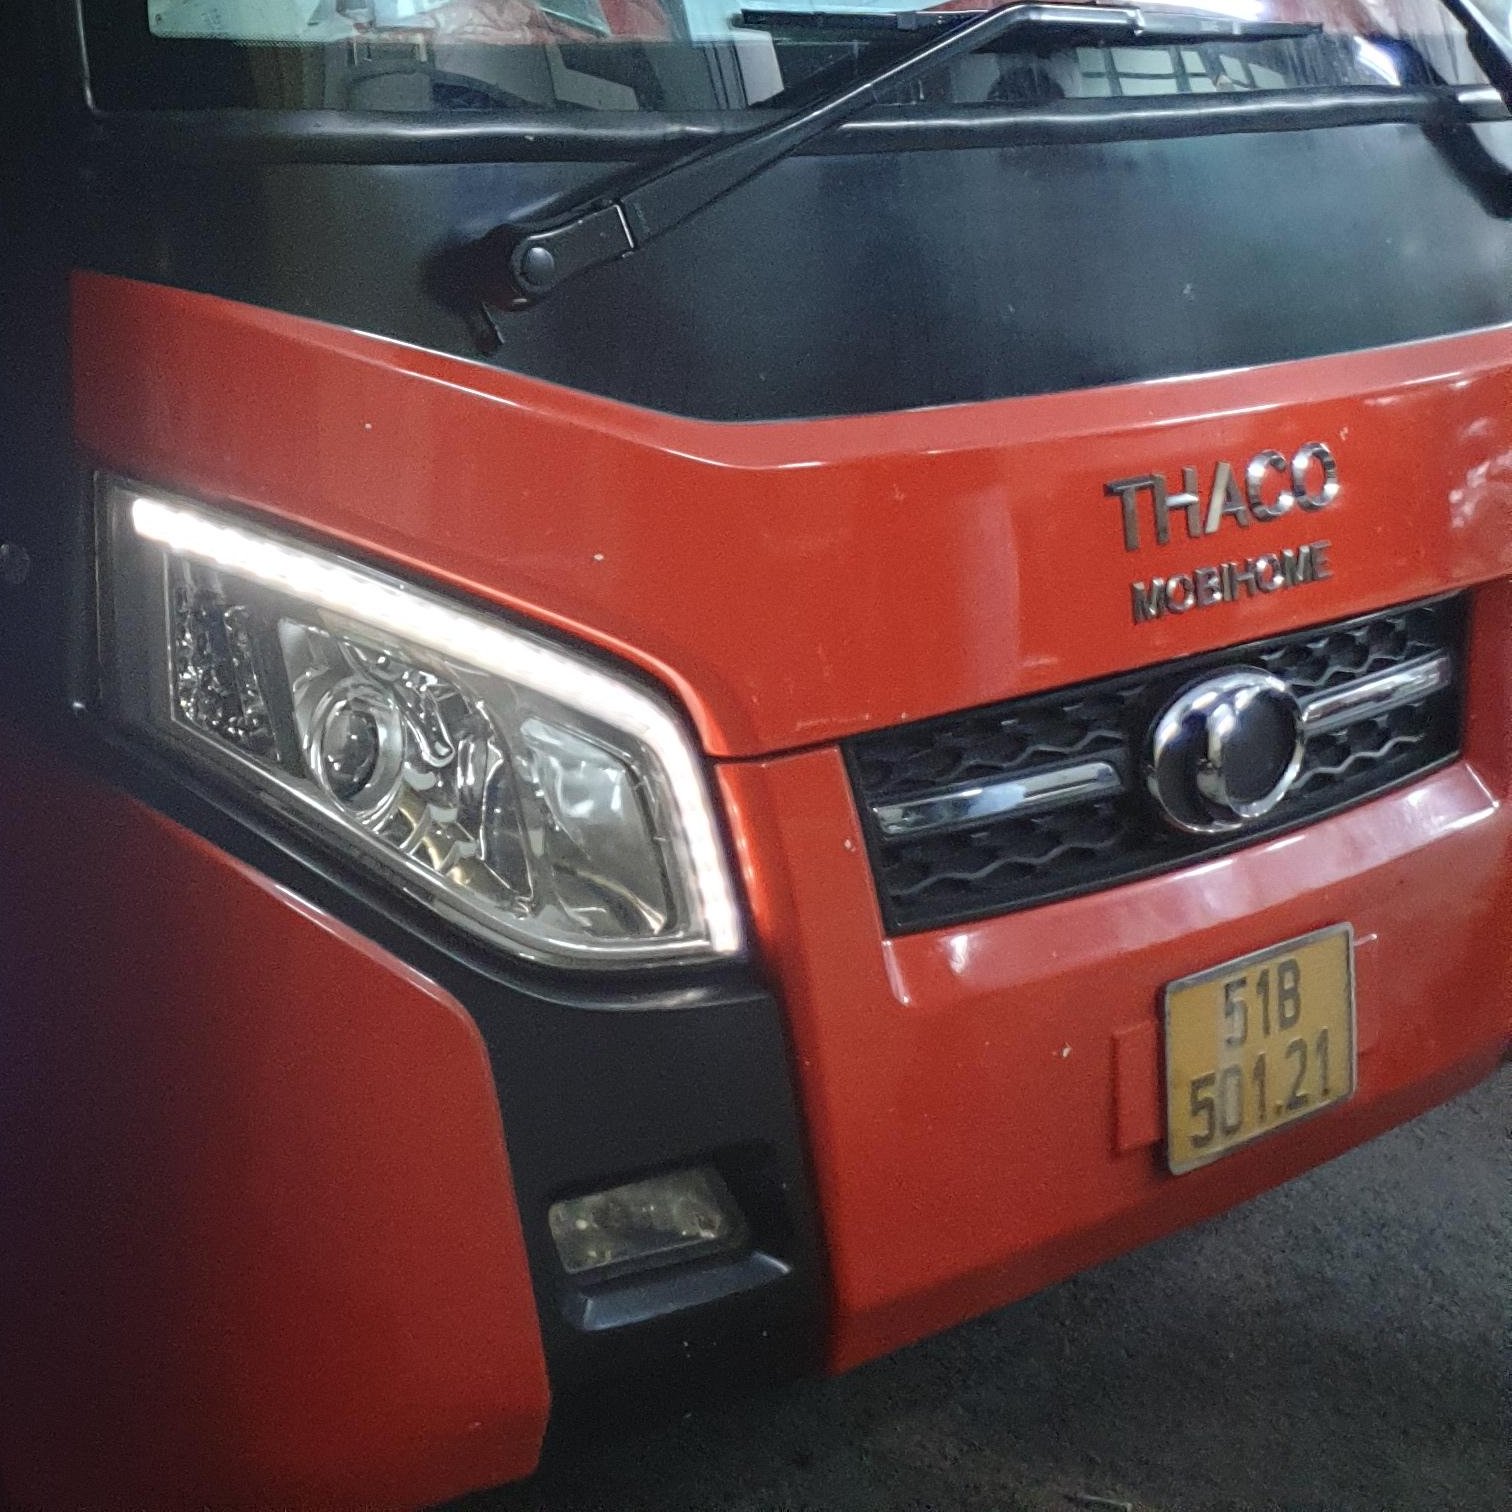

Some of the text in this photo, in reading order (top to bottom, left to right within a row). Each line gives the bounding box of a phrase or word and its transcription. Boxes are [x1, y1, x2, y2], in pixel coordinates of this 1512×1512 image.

[1103, 441, 1341, 552] THACO
[1131, 540, 1333, 626] MOBIHOME
[1223, 957, 1302, 1049] 51B
[1190, 1025, 1331, 1149] 501.21
